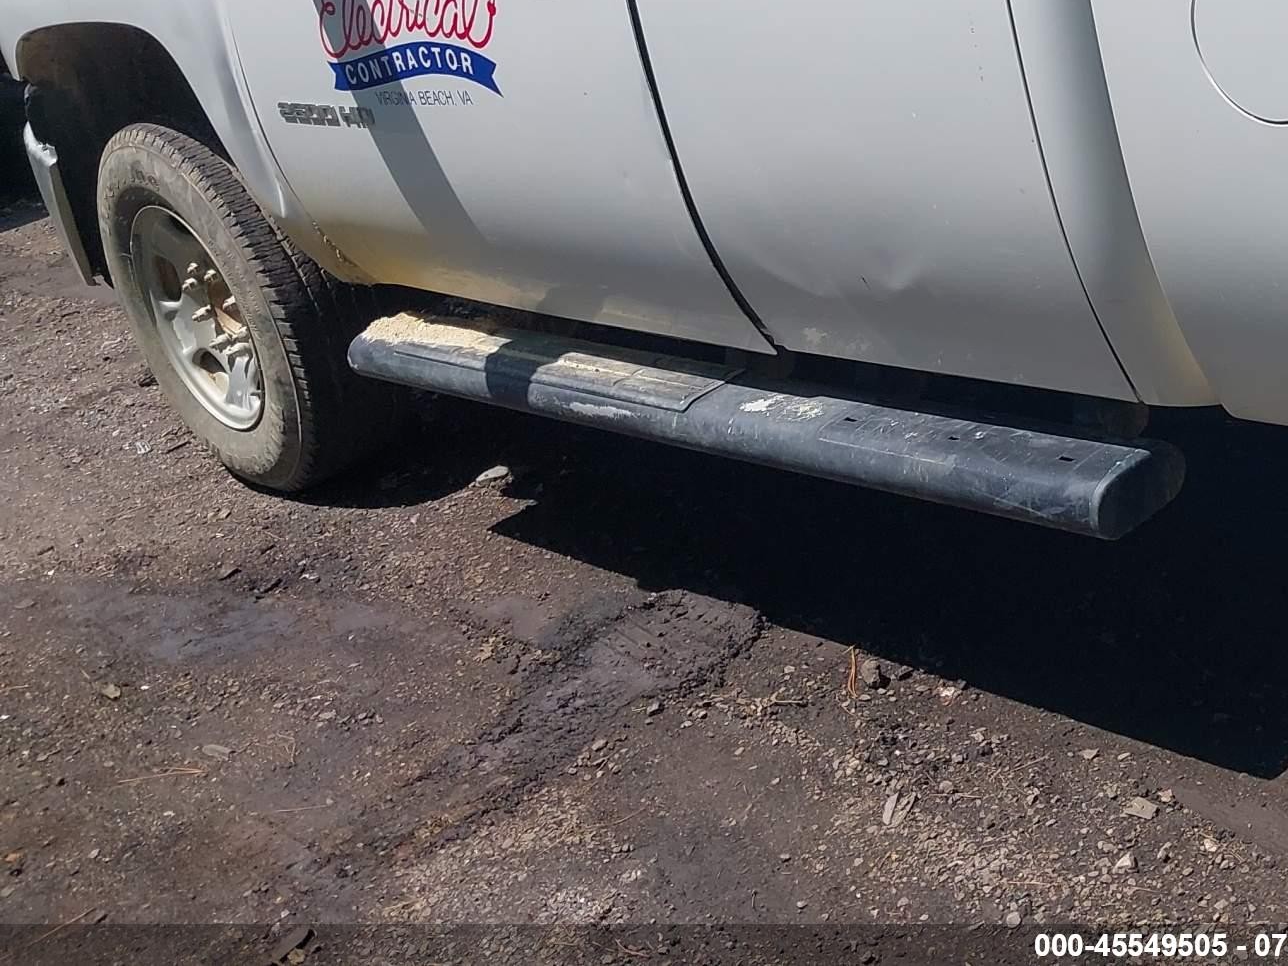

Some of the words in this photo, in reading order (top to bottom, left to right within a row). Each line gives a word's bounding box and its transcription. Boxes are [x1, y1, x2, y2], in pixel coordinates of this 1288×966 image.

[345, 46, 474, 85] CONTRACTOR
[375, 89, 417, 106] VIRGINIA
[457, 89, 474, 105] VA
